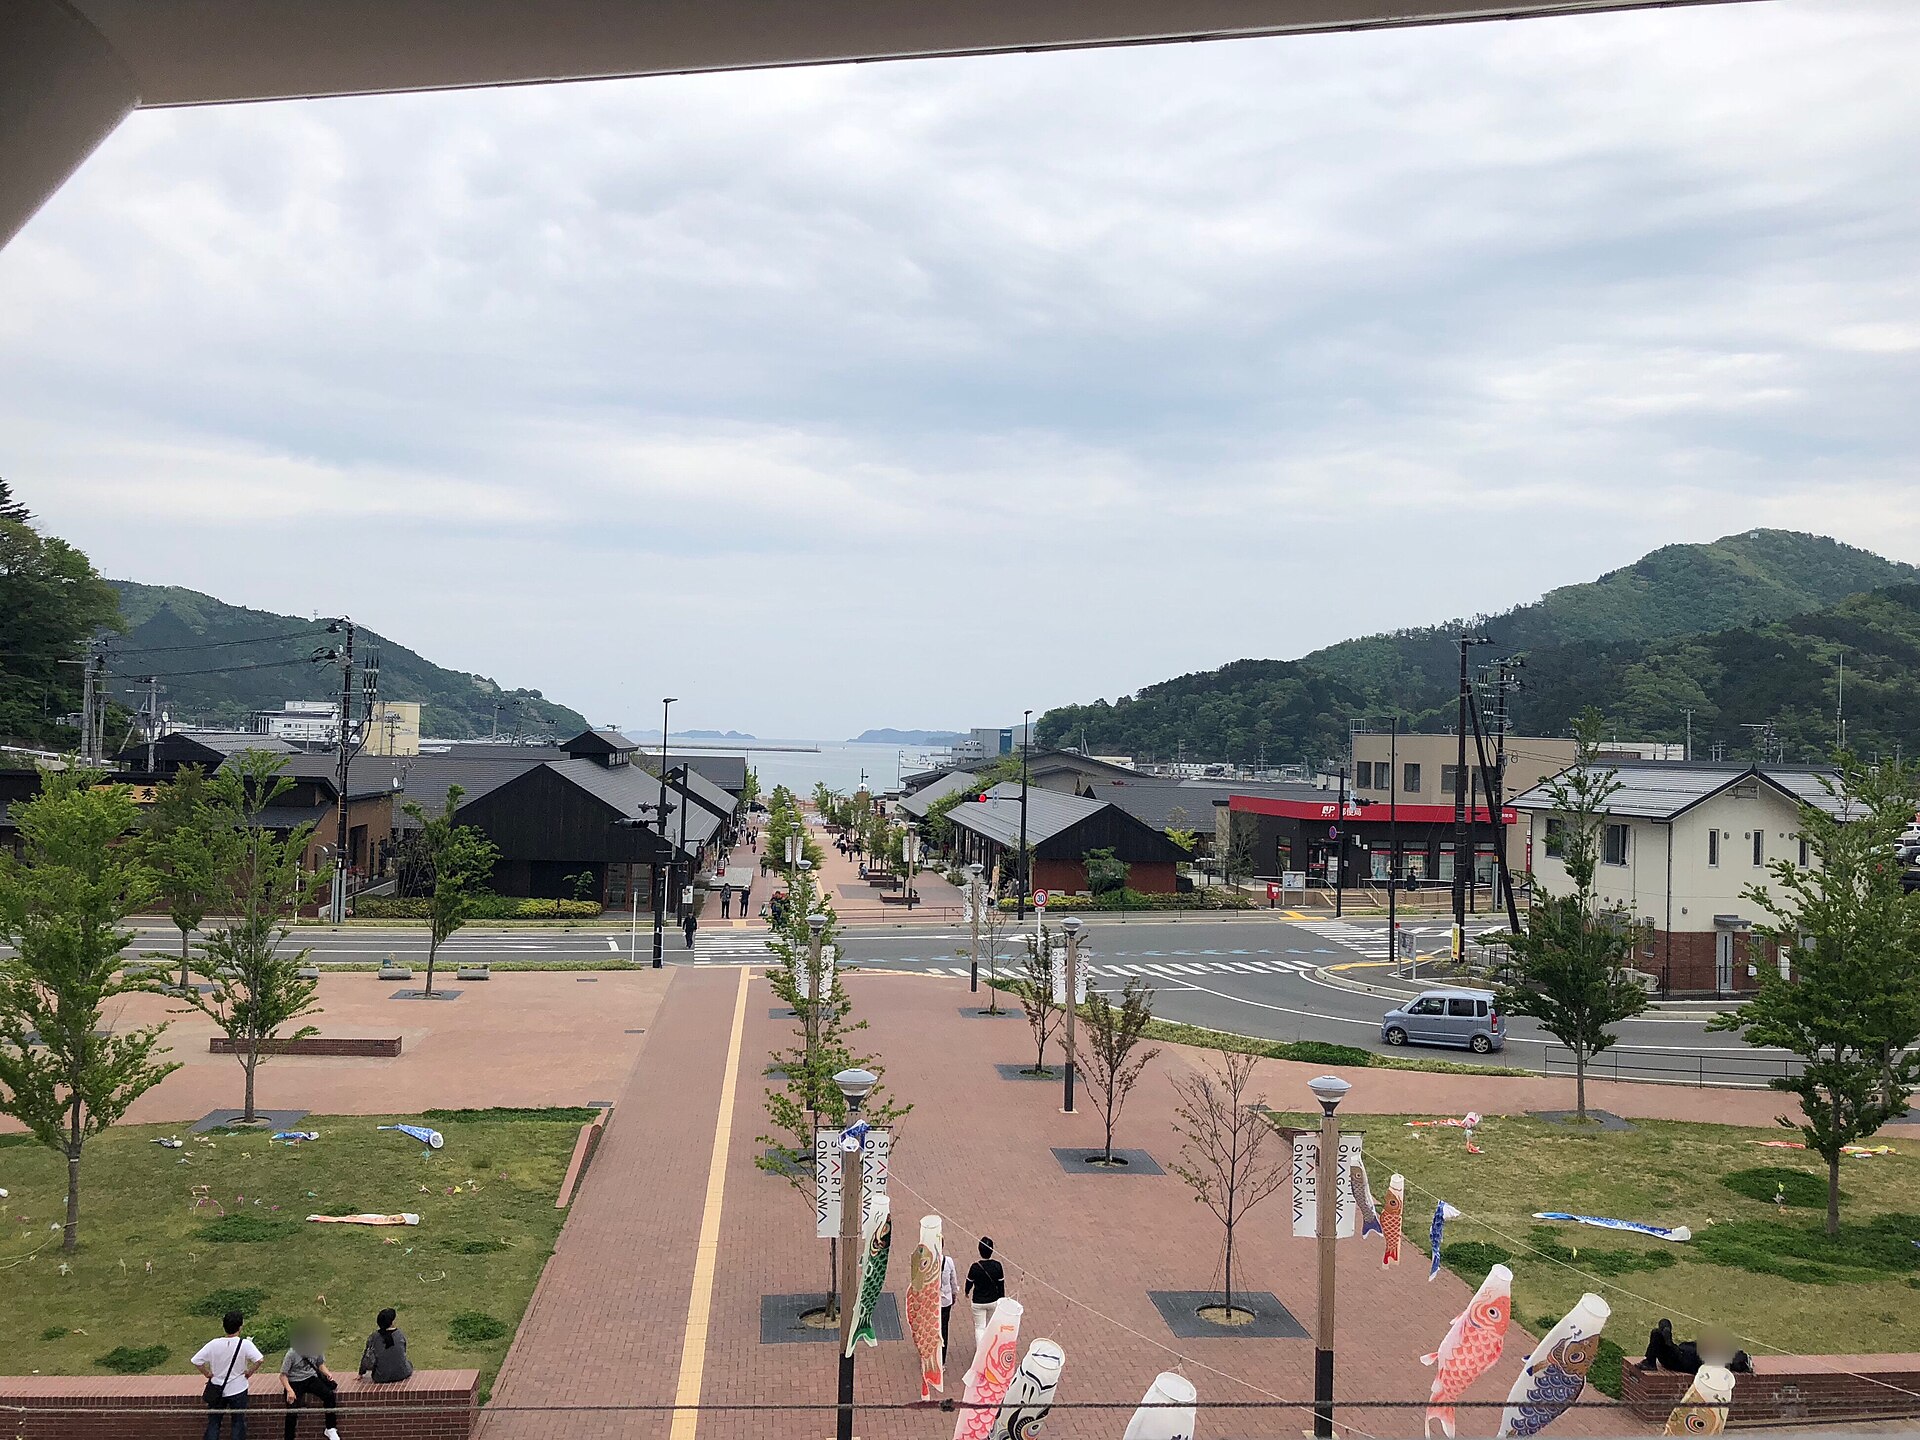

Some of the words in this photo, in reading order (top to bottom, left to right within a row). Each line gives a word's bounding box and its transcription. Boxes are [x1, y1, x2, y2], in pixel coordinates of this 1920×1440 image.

[1036, 894, 1045, 903] 30
[817, 1140, 828, 1224] ONAGAWA
[831, 1141, 841, 1203] START!
[862, 1140, 875, 1224] ONAGAWA
[1293, 1143, 1303, 1223] ONAGAWA
[1306, 1144, 1316, 1202] START!
[1336, 1144, 1349, 1225] ONAGAWA
